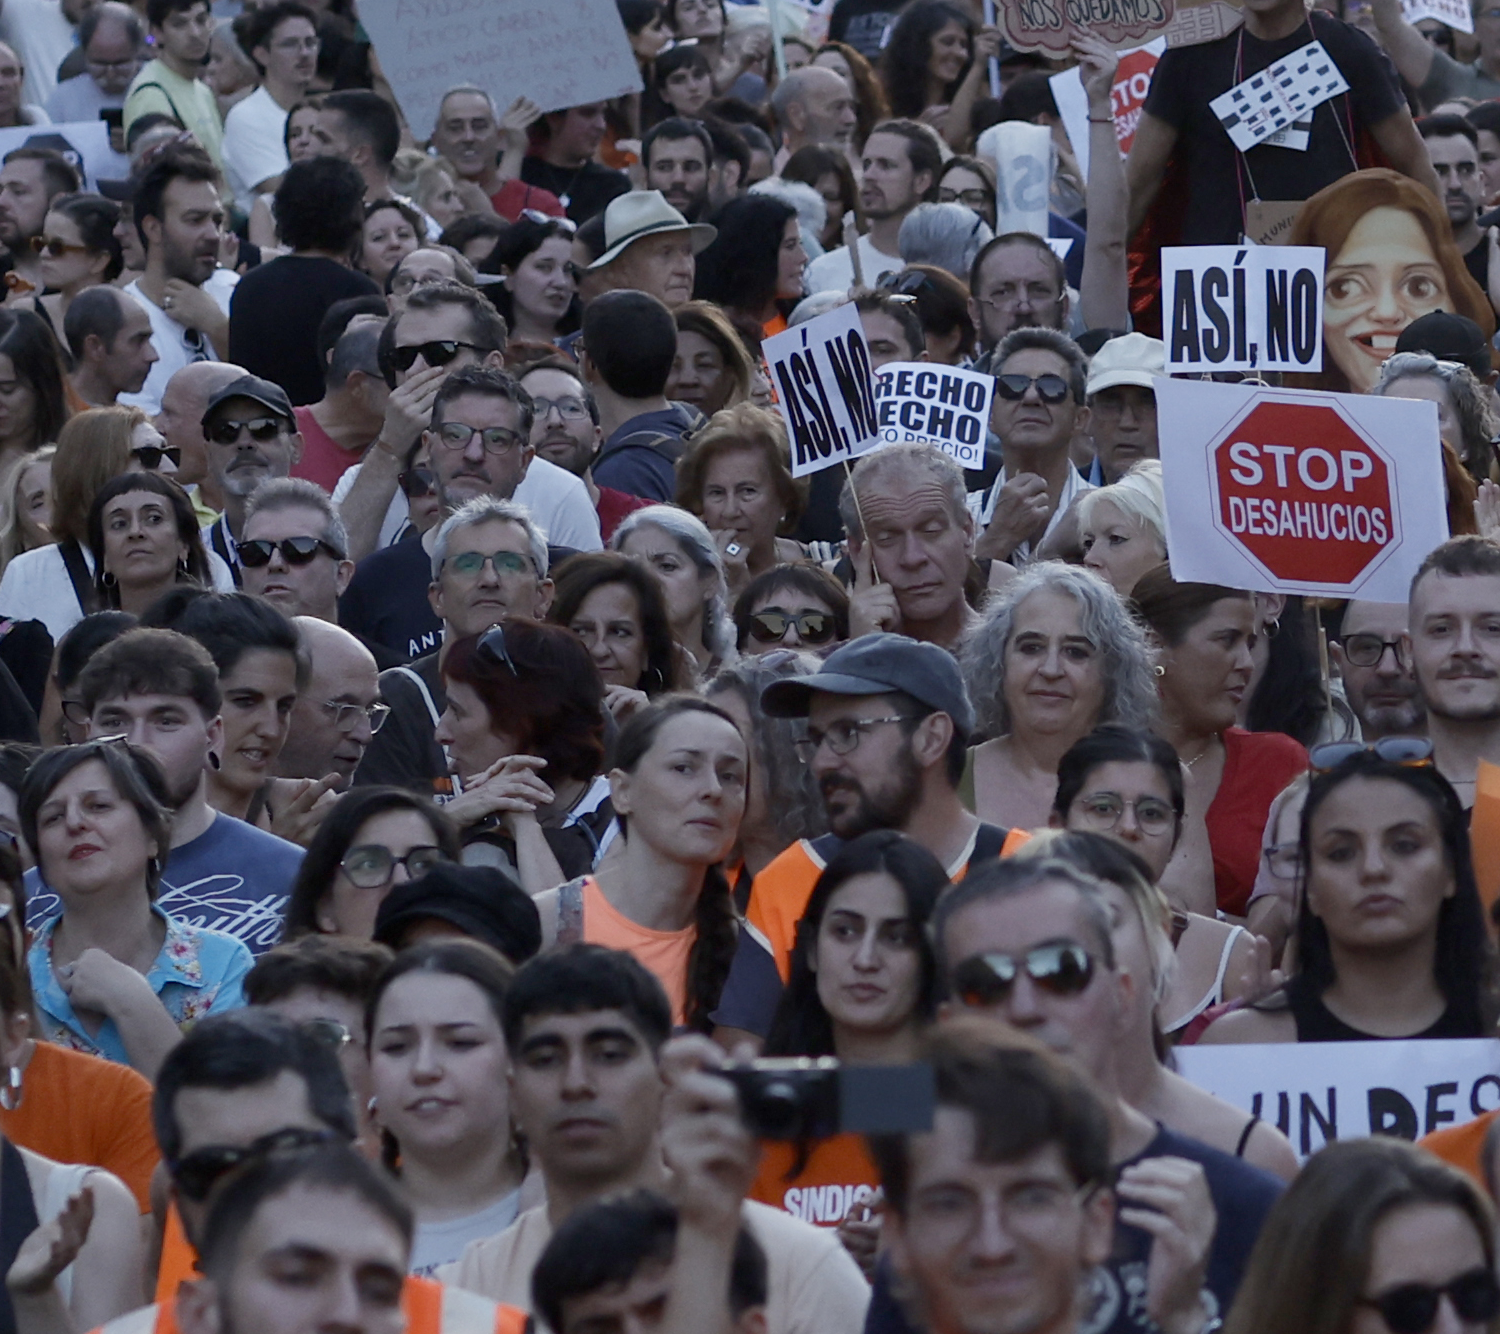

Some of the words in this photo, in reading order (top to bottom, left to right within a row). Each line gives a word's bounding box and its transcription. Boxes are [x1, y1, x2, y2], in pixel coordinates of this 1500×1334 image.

[1170, 249, 1258, 369] ASÍ,
[1266, 267, 1318, 366] NO
[774, 327, 852, 466] ASÍ,
[824, 327, 878, 443] NO
[1228, 442, 1374, 493] STOP
[1228, 496, 1388, 546] DESAHUCIOS
